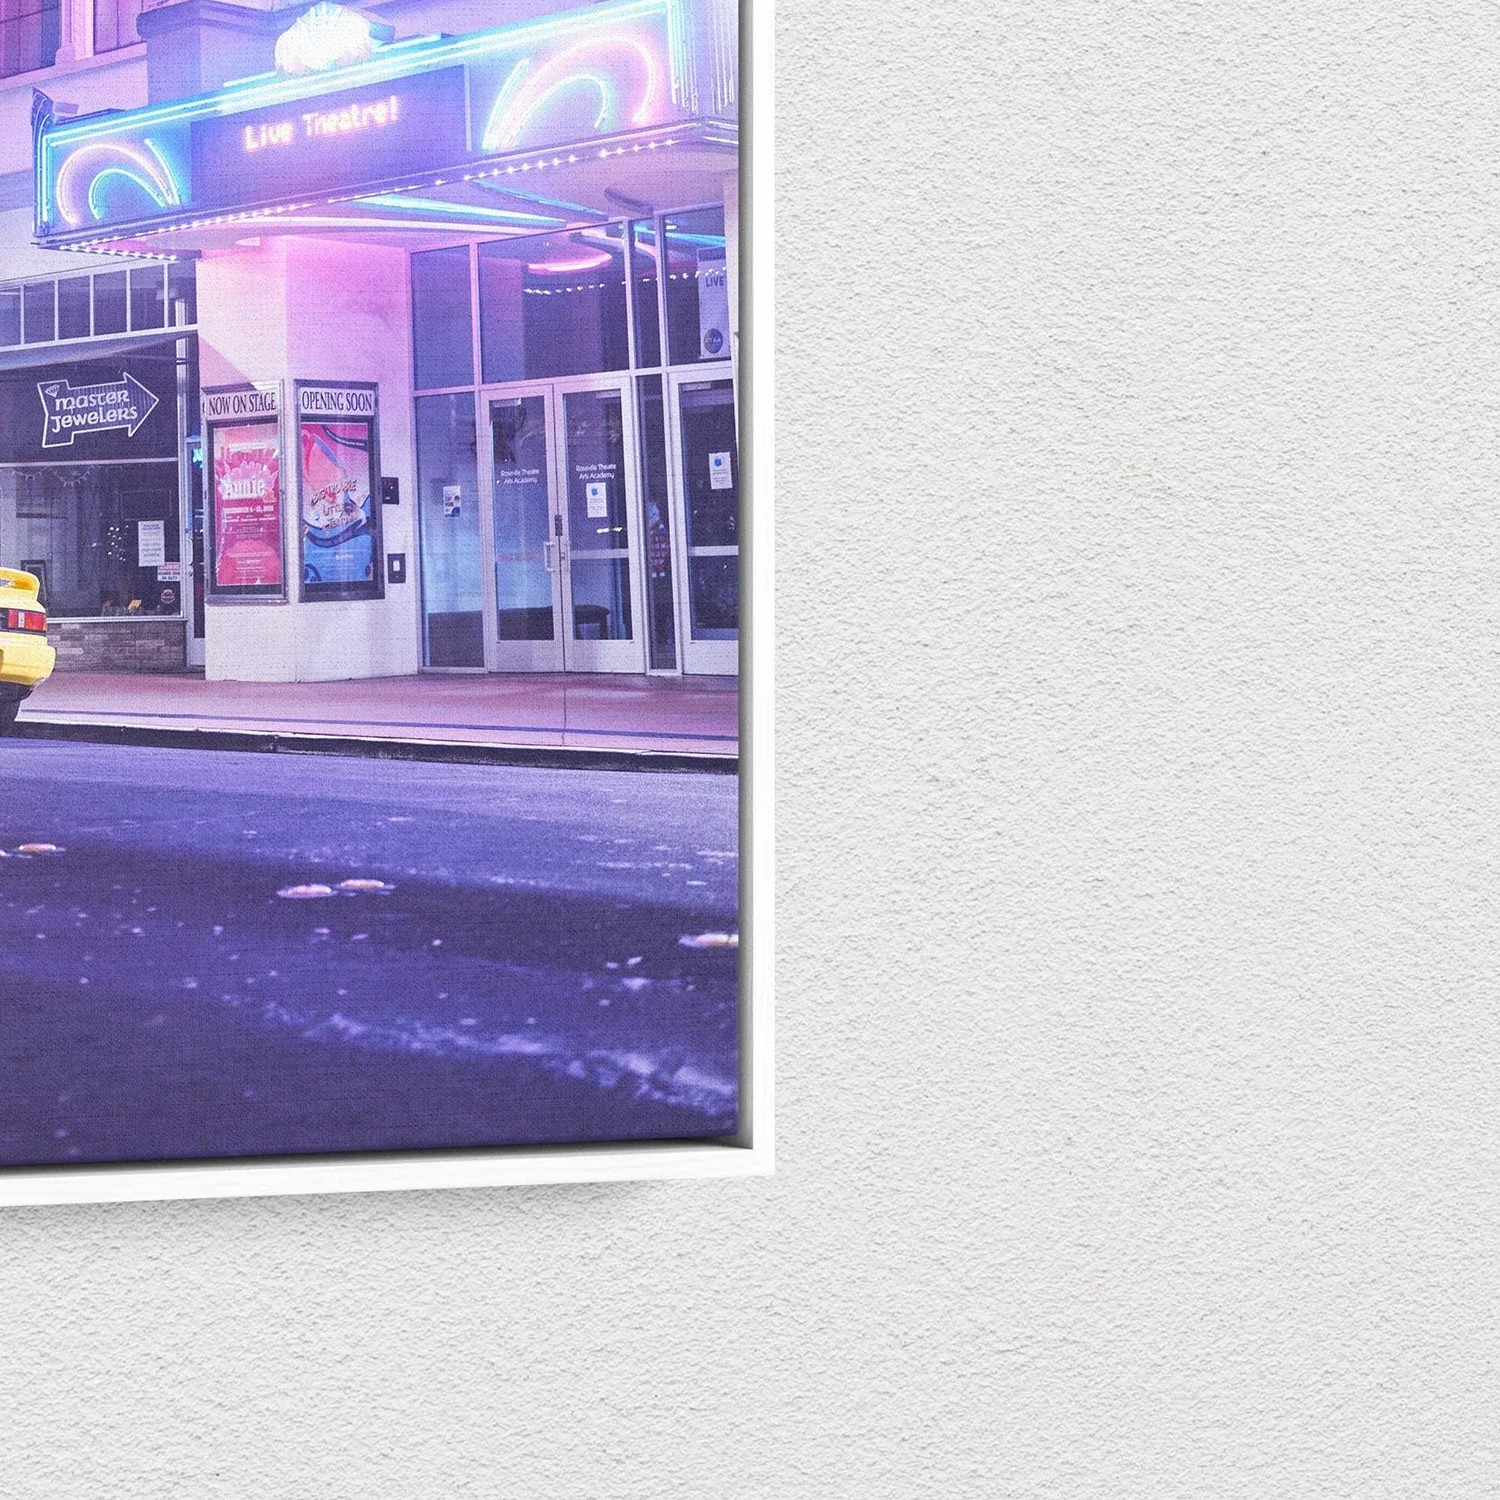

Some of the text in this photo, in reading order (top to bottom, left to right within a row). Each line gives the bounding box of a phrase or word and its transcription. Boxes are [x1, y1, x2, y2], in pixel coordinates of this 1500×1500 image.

[245, 94, 398, 151] Live Theatre!
[705, 275, 725, 288] LIVE
[208, 392, 277, 416] NOW ON STAGE
[302, 391, 373, 412] OPENING SOON
[590, 471, 615, 480] Academy
